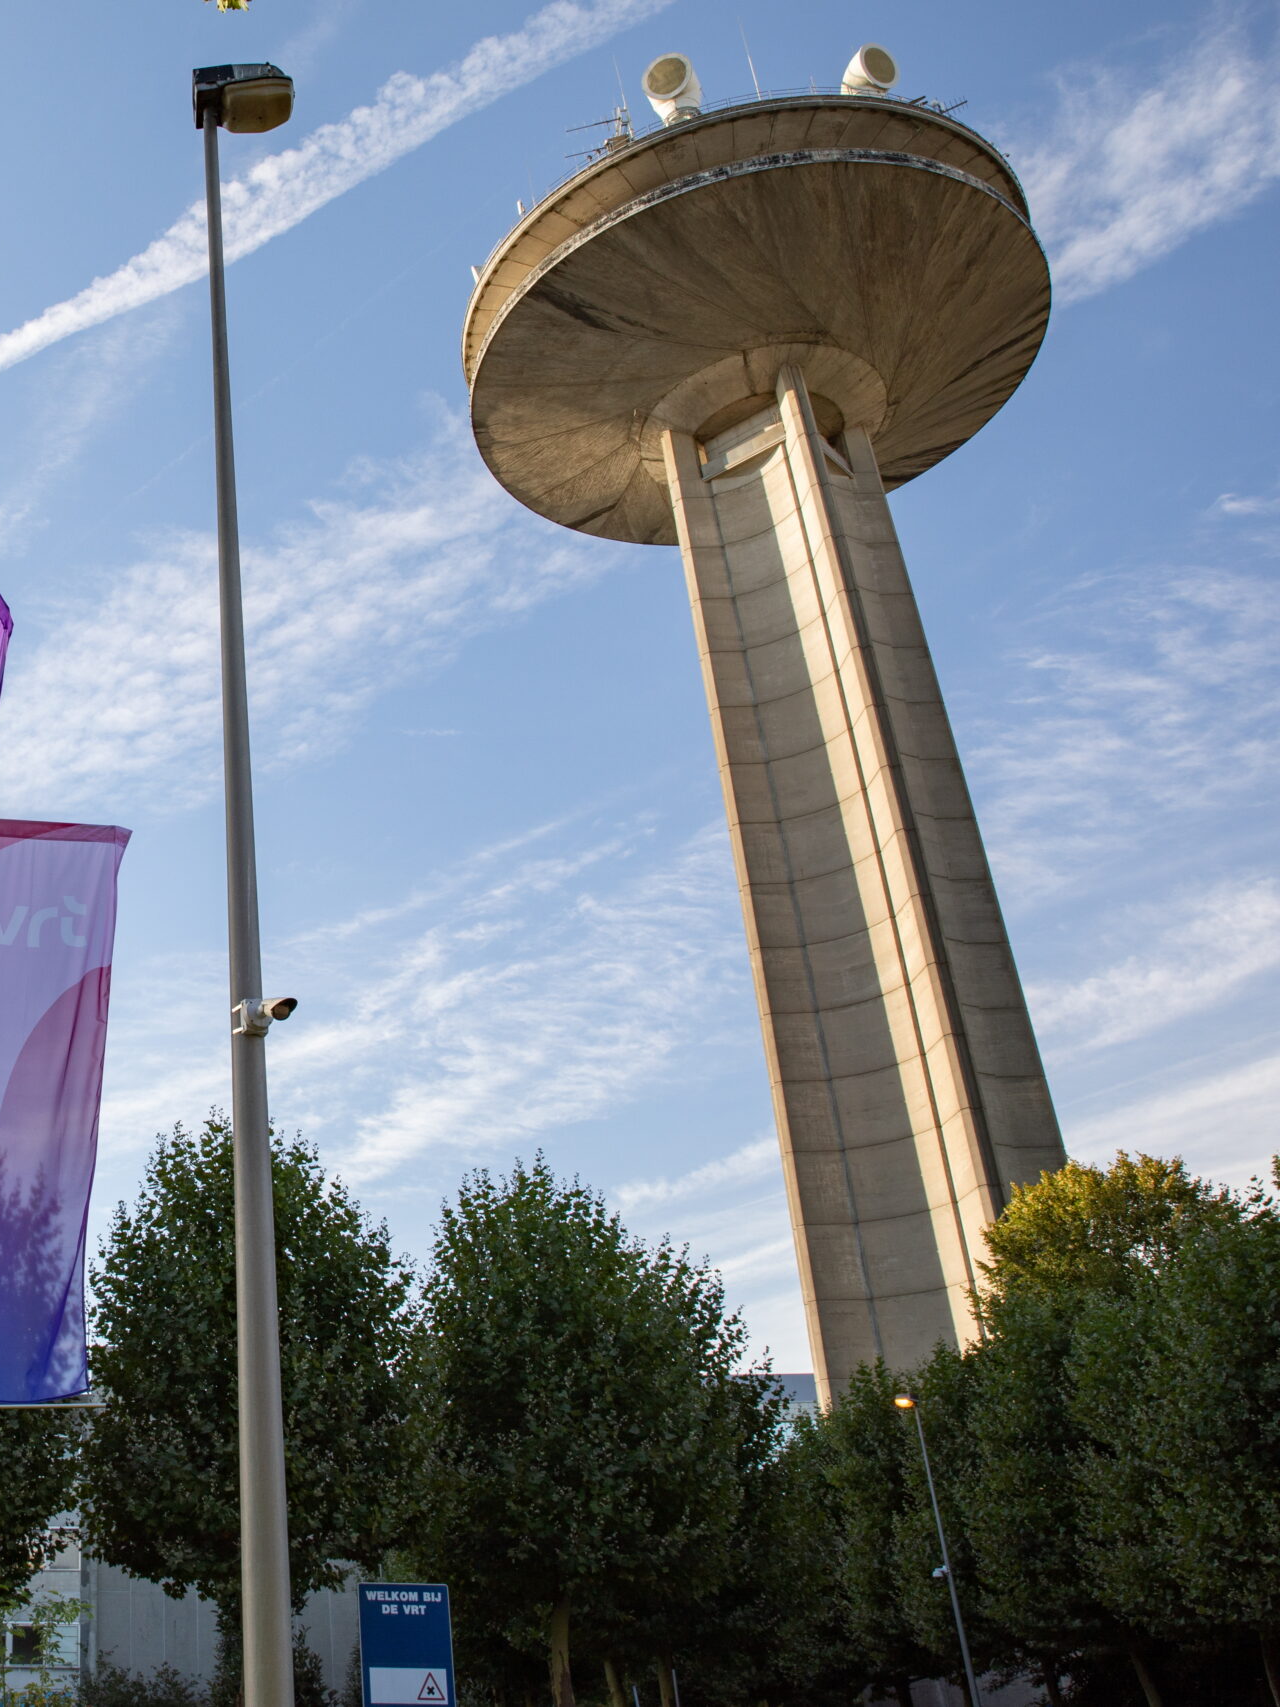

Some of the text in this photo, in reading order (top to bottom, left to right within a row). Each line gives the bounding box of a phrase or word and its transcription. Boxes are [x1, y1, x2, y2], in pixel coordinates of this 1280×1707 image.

[365, 1590, 442, 1602] WELKOM BIJ
[381, 1604, 427, 1616] DE VRT
